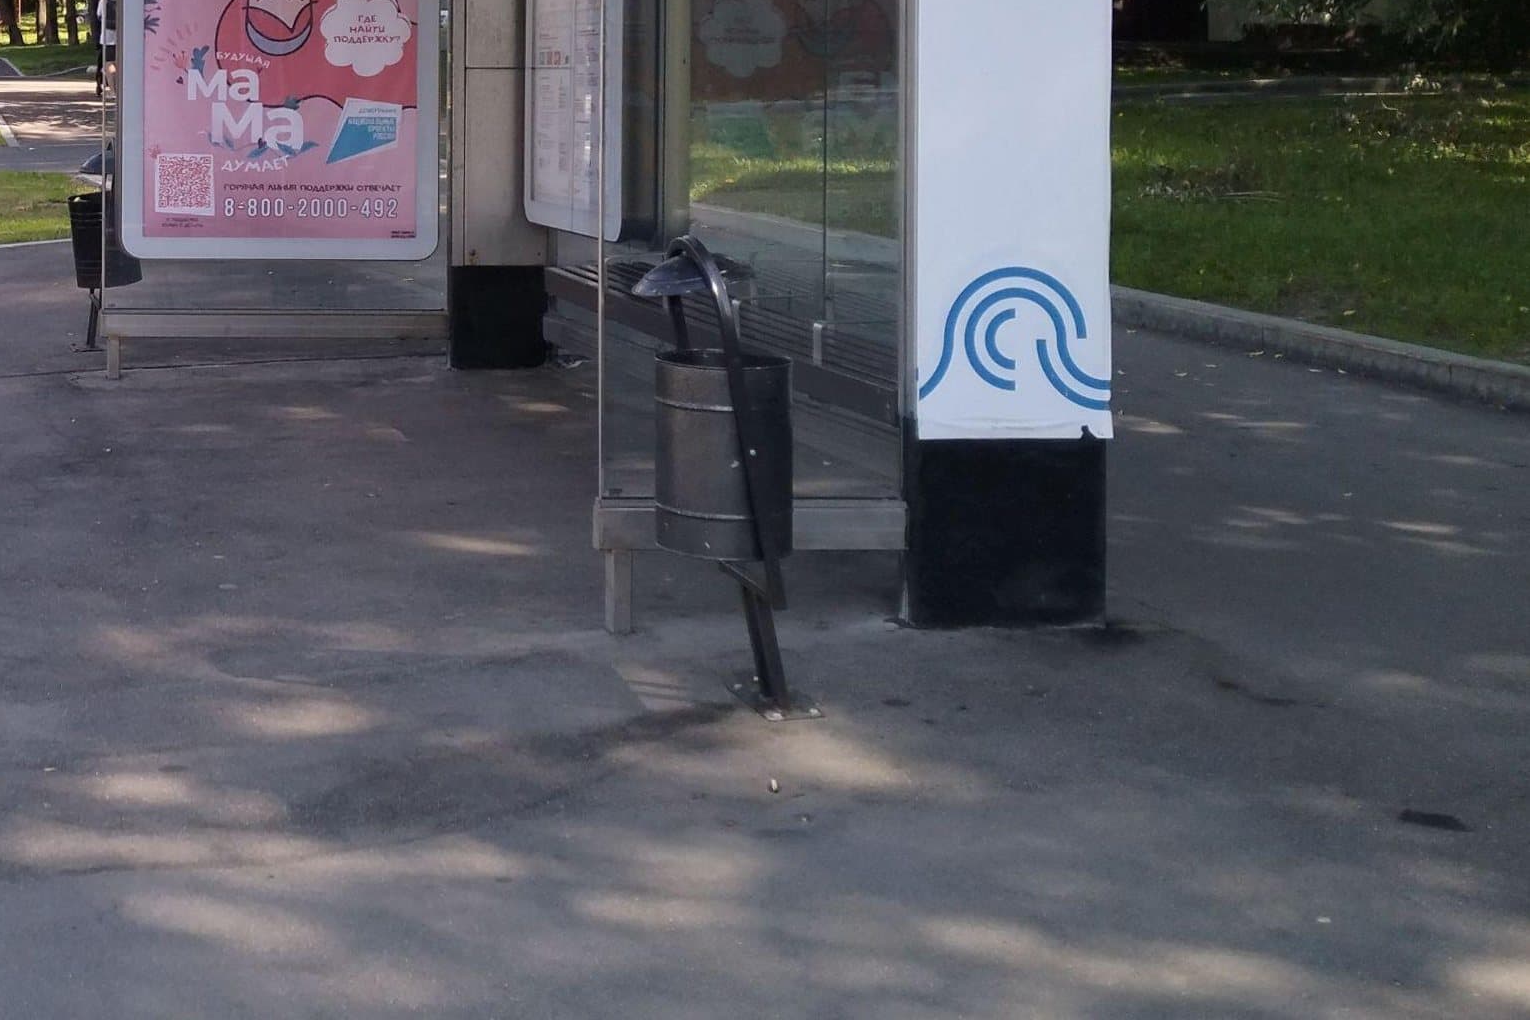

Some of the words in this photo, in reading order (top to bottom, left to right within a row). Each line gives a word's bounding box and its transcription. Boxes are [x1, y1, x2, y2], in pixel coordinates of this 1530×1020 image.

[357, 14, 377, 23] ГДЕ
[349, 25, 386, 33] НАЙТИ
[333, 35, 401, 44] ПОДДЕРЖКУ?
[221, 154, 290, 172] ДУМАЕТ
[223, 197, 399, 219] 8-800-2000-492
